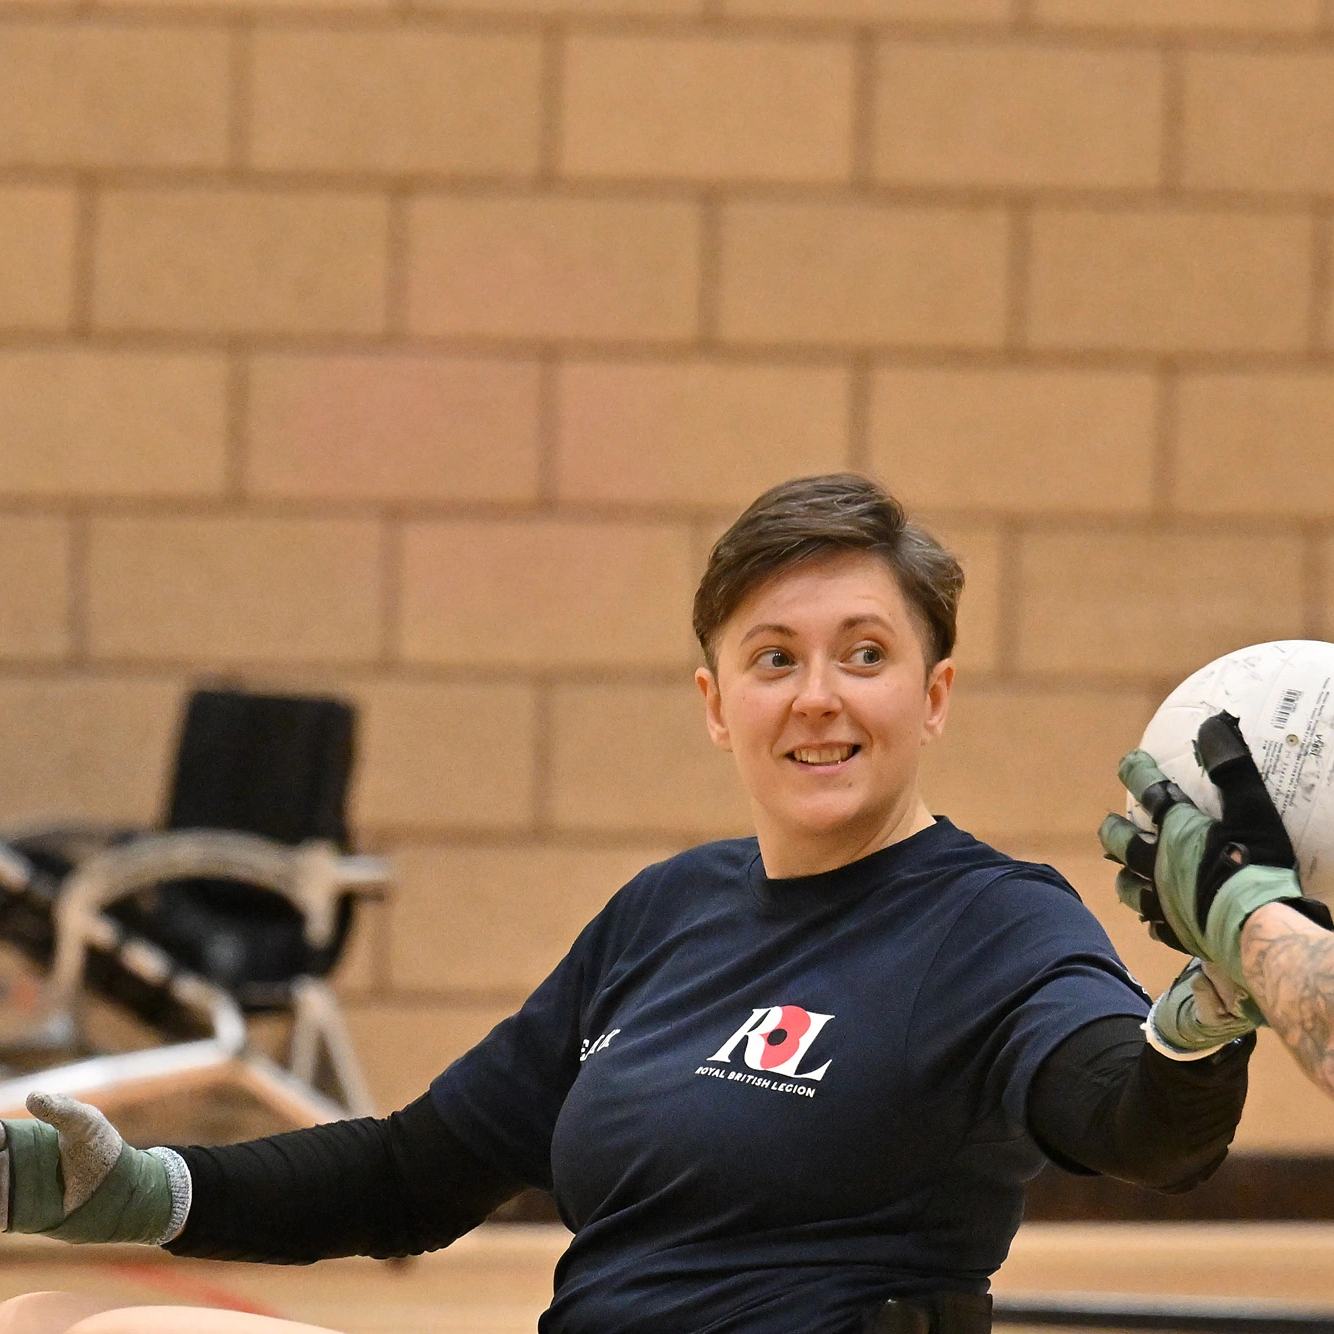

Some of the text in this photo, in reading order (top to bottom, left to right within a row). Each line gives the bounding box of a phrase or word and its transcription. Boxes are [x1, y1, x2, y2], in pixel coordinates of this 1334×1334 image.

[695, 1066, 816, 1099] ROYAL BRITISH LEGION
